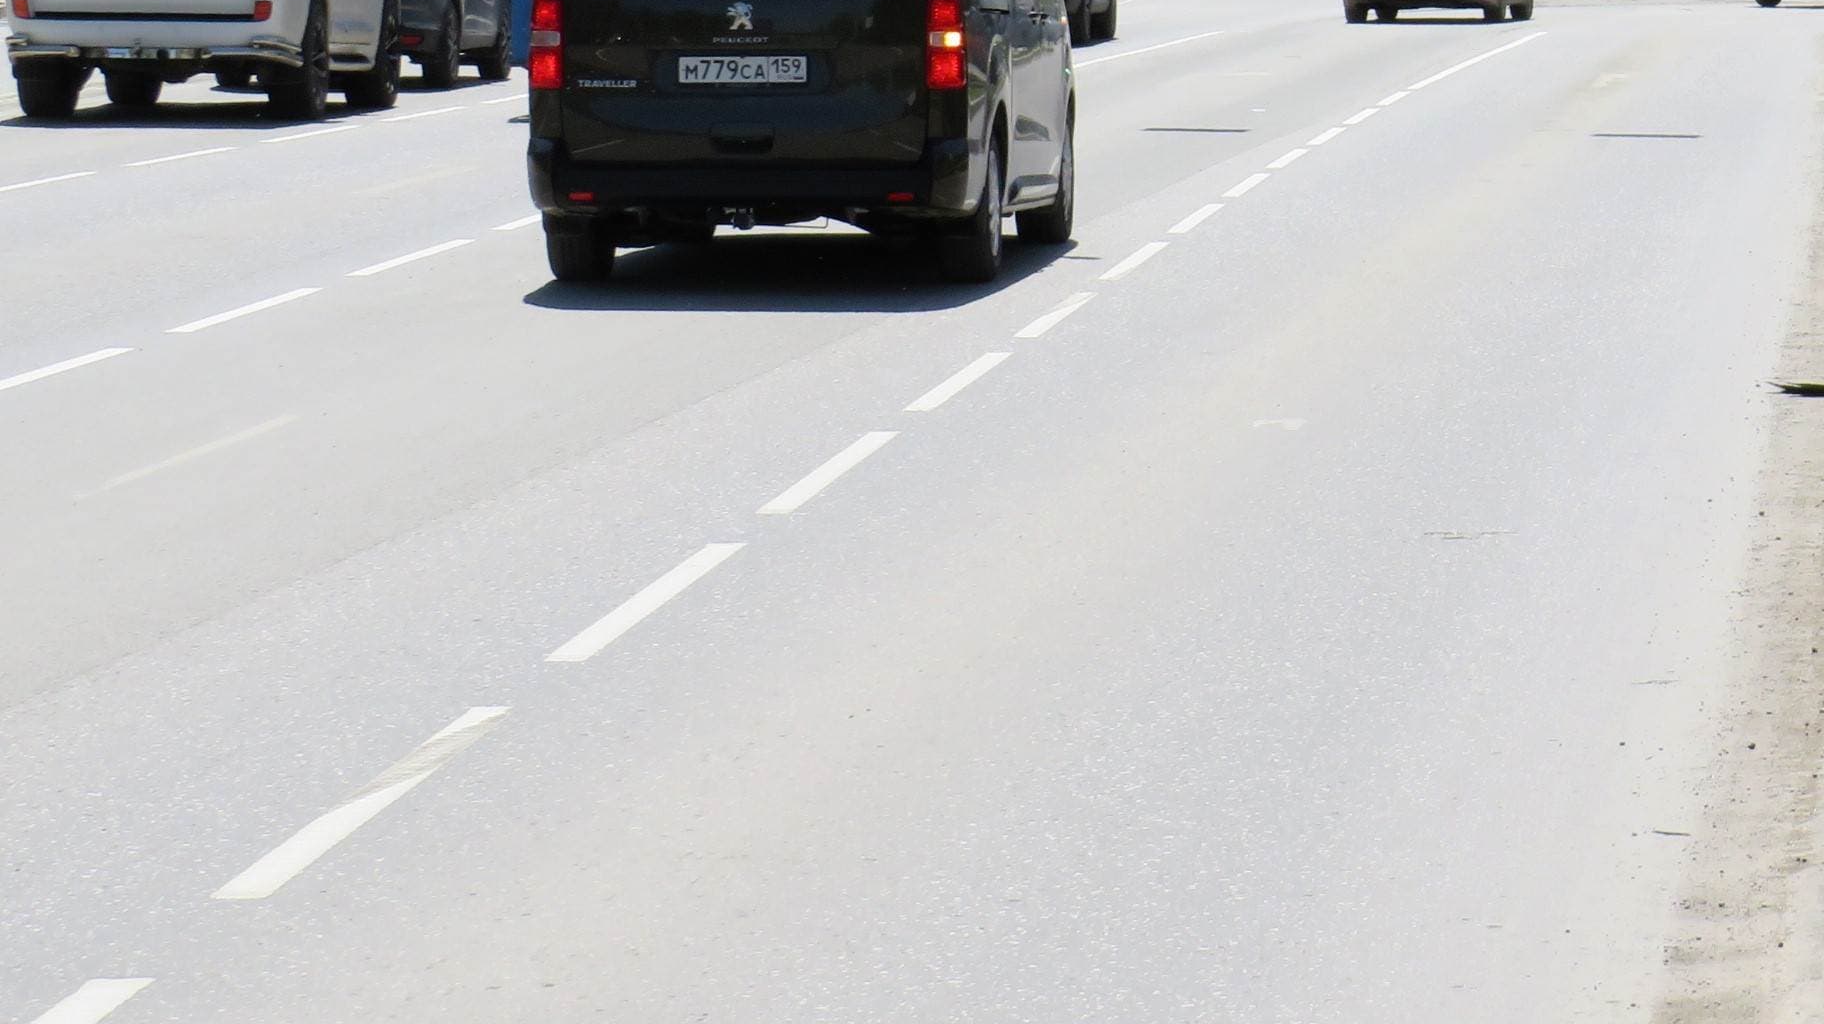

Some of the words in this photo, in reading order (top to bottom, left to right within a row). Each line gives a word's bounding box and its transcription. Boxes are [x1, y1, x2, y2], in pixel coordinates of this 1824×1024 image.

[712, 36, 769, 44] PEUGEOT
[684, 59, 766, 81] М779СА
[771, 58, 802, 74] 159
[577, 79, 638, 88] TRAVELLER
